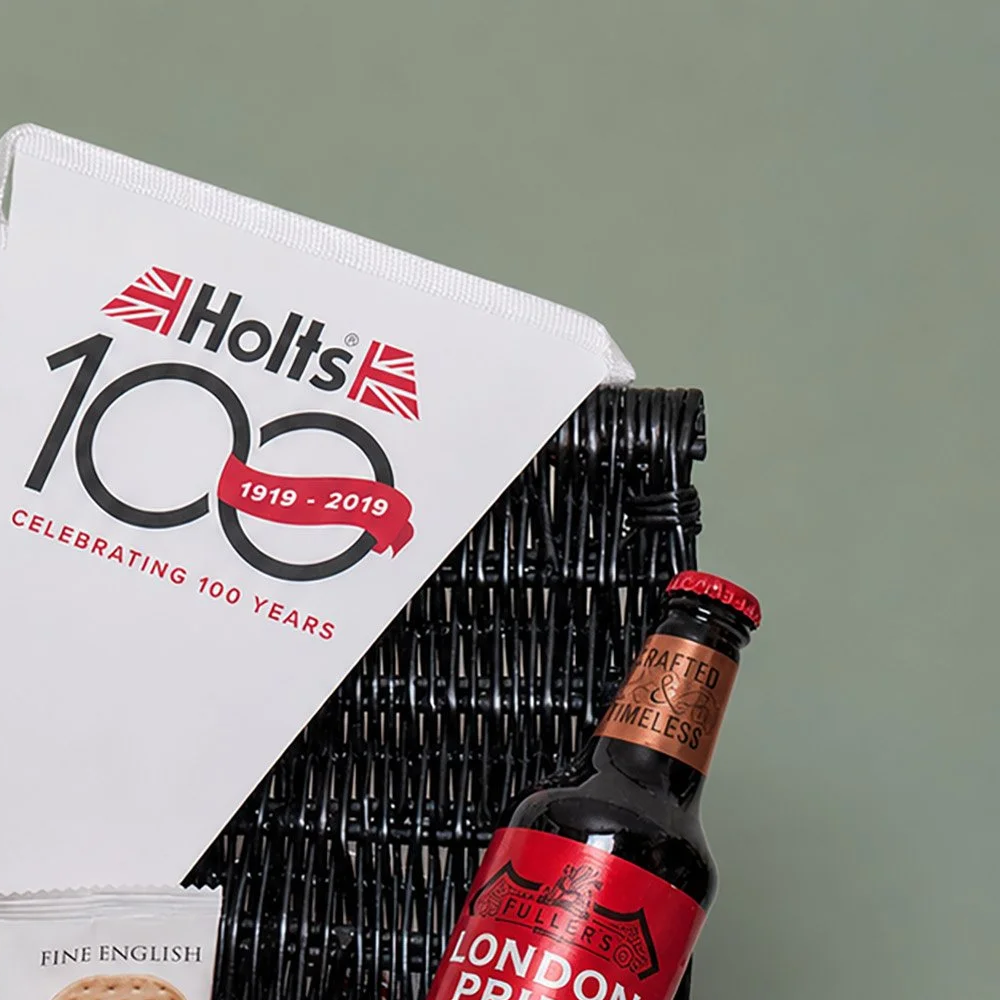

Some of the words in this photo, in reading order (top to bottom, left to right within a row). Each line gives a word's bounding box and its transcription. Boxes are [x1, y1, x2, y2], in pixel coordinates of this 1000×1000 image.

[23, 332, 396, 583] 100
[238, 480, 298, 510] 1919
[323, 490, 390, 518] 2019
[10, 508, 188, 586] CELEBRATING
[197, 576, 242, 606] 100
[253, 595, 336, 642] YEARS
[651, 671, 685, 715] &
[606, 702, 703, 750] TIMELESS
[41, 946, 91, 966] FINE
[99, 945, 202, 963] ENGLISH
